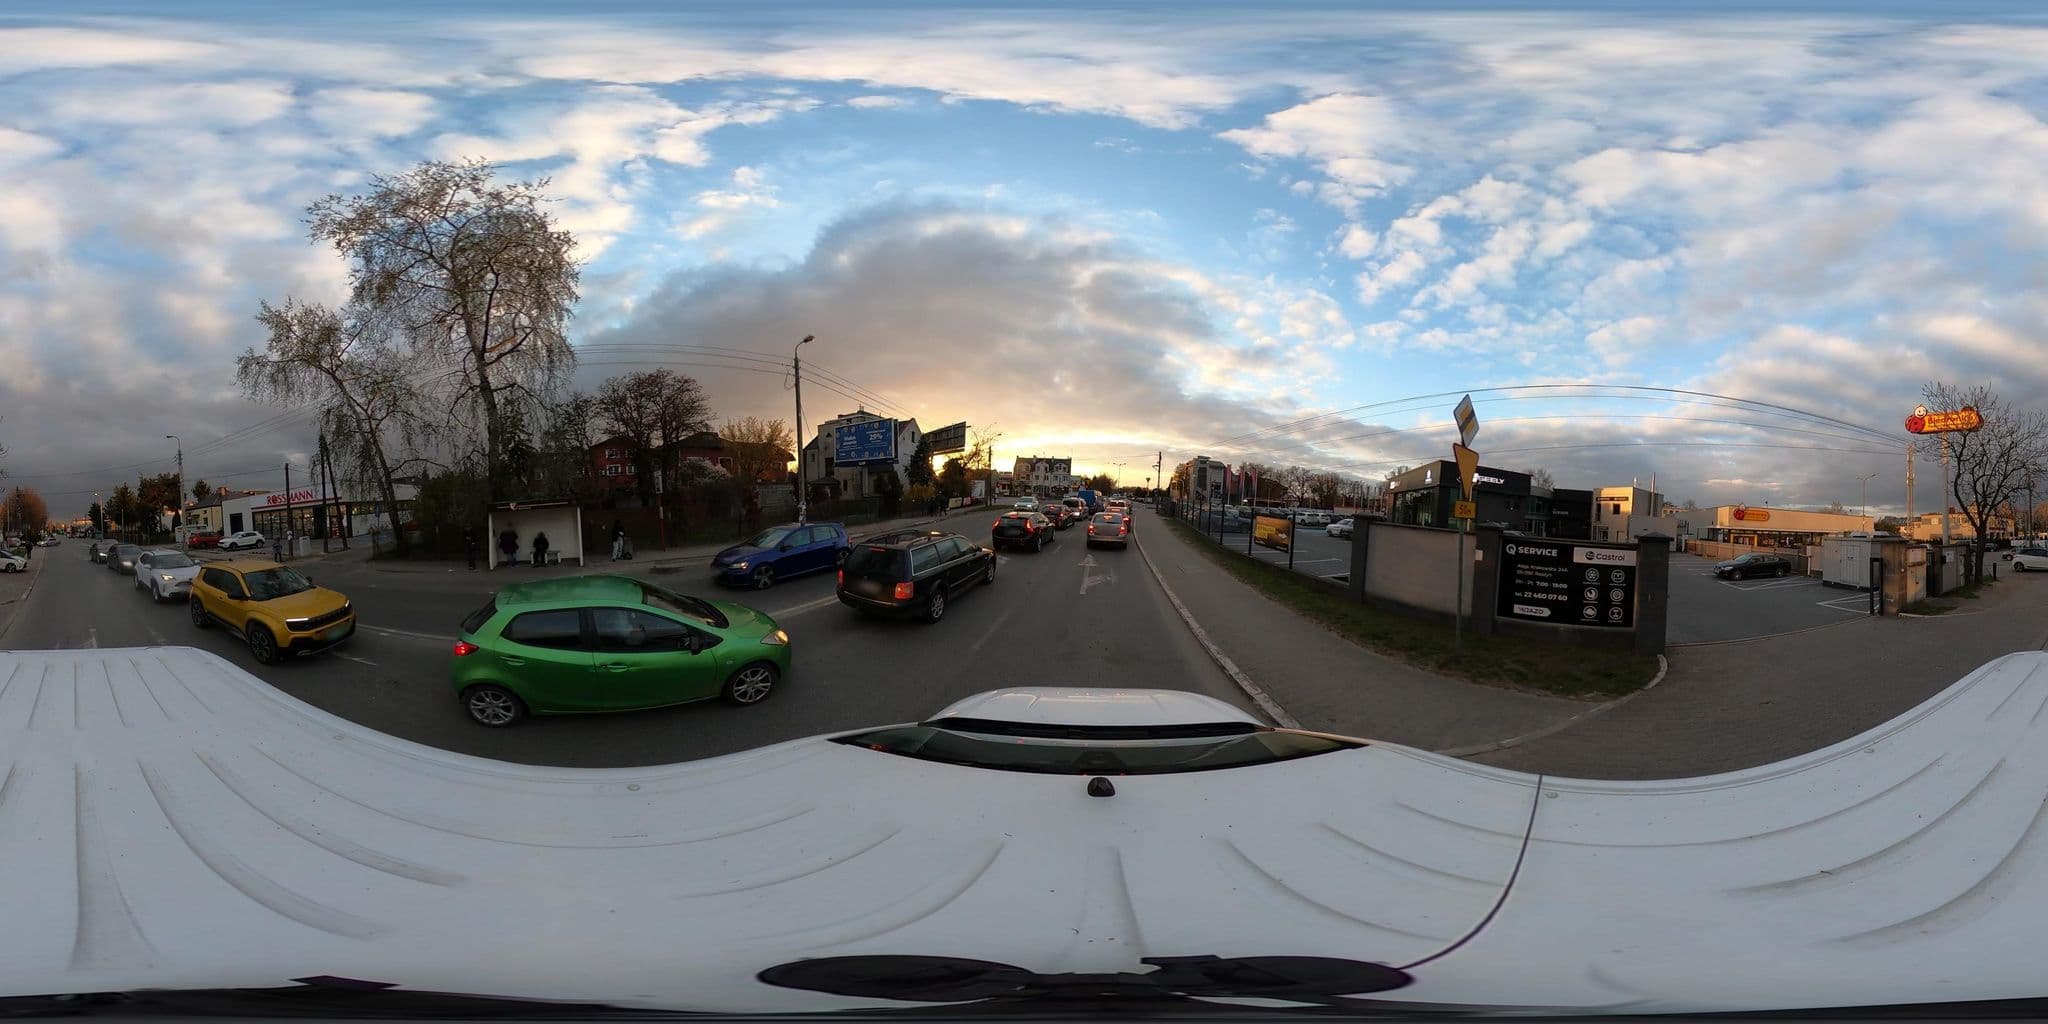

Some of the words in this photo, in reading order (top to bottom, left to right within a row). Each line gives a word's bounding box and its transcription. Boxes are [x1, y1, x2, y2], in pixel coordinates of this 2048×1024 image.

[1506, 543, 1517, 555] Q
[1518, 546, 1558, 557] SERVICE
[1596, 552, 1625, 561] Castrol
